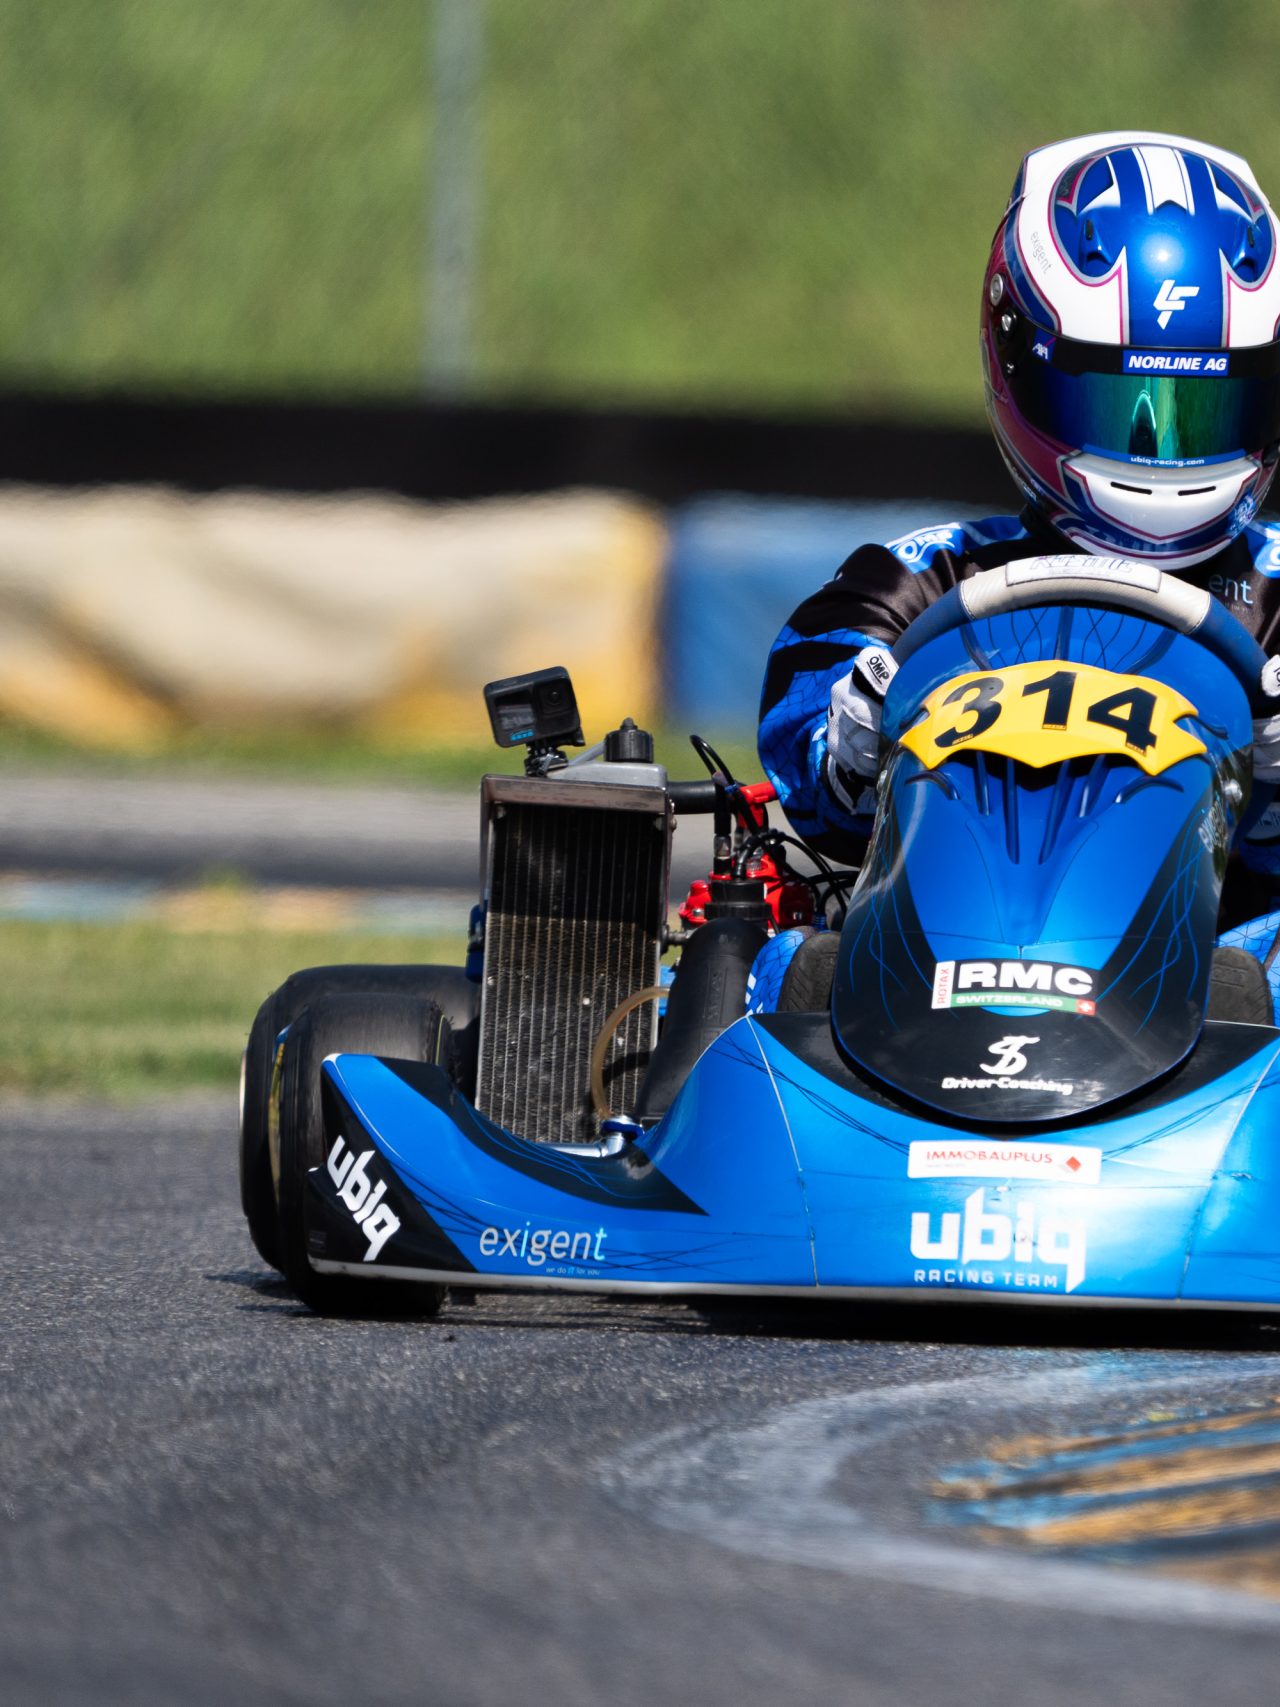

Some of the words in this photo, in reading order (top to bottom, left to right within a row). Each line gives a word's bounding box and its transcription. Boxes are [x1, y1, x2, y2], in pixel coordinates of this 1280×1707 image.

[1128, 355, 1202, 370] NORLINE
[1203, 358, 1227, 371] AG
[1130, 456, 1205, 467] ubiq-racing.com
[869, 656, 890, 680] OMP
[934, 671, 1158, 754] 314
[937, 967, 951, 1004] ROTAX
[958, 962, 1093, 995] RMC
[956, 993, 1063, 1008] SWITZERLAND
[926, 1150, 1054, 1164] IMMOBAUPLUS
[327, 1135, 401, 1262] ubiq
[479, 1221, 608, 1266] exigent
[910, 1186, 1088, 1293] ubiq
[914, 1269, 995, 1285] RACING
[1003, 1272, 1059, 1288] TEAM
